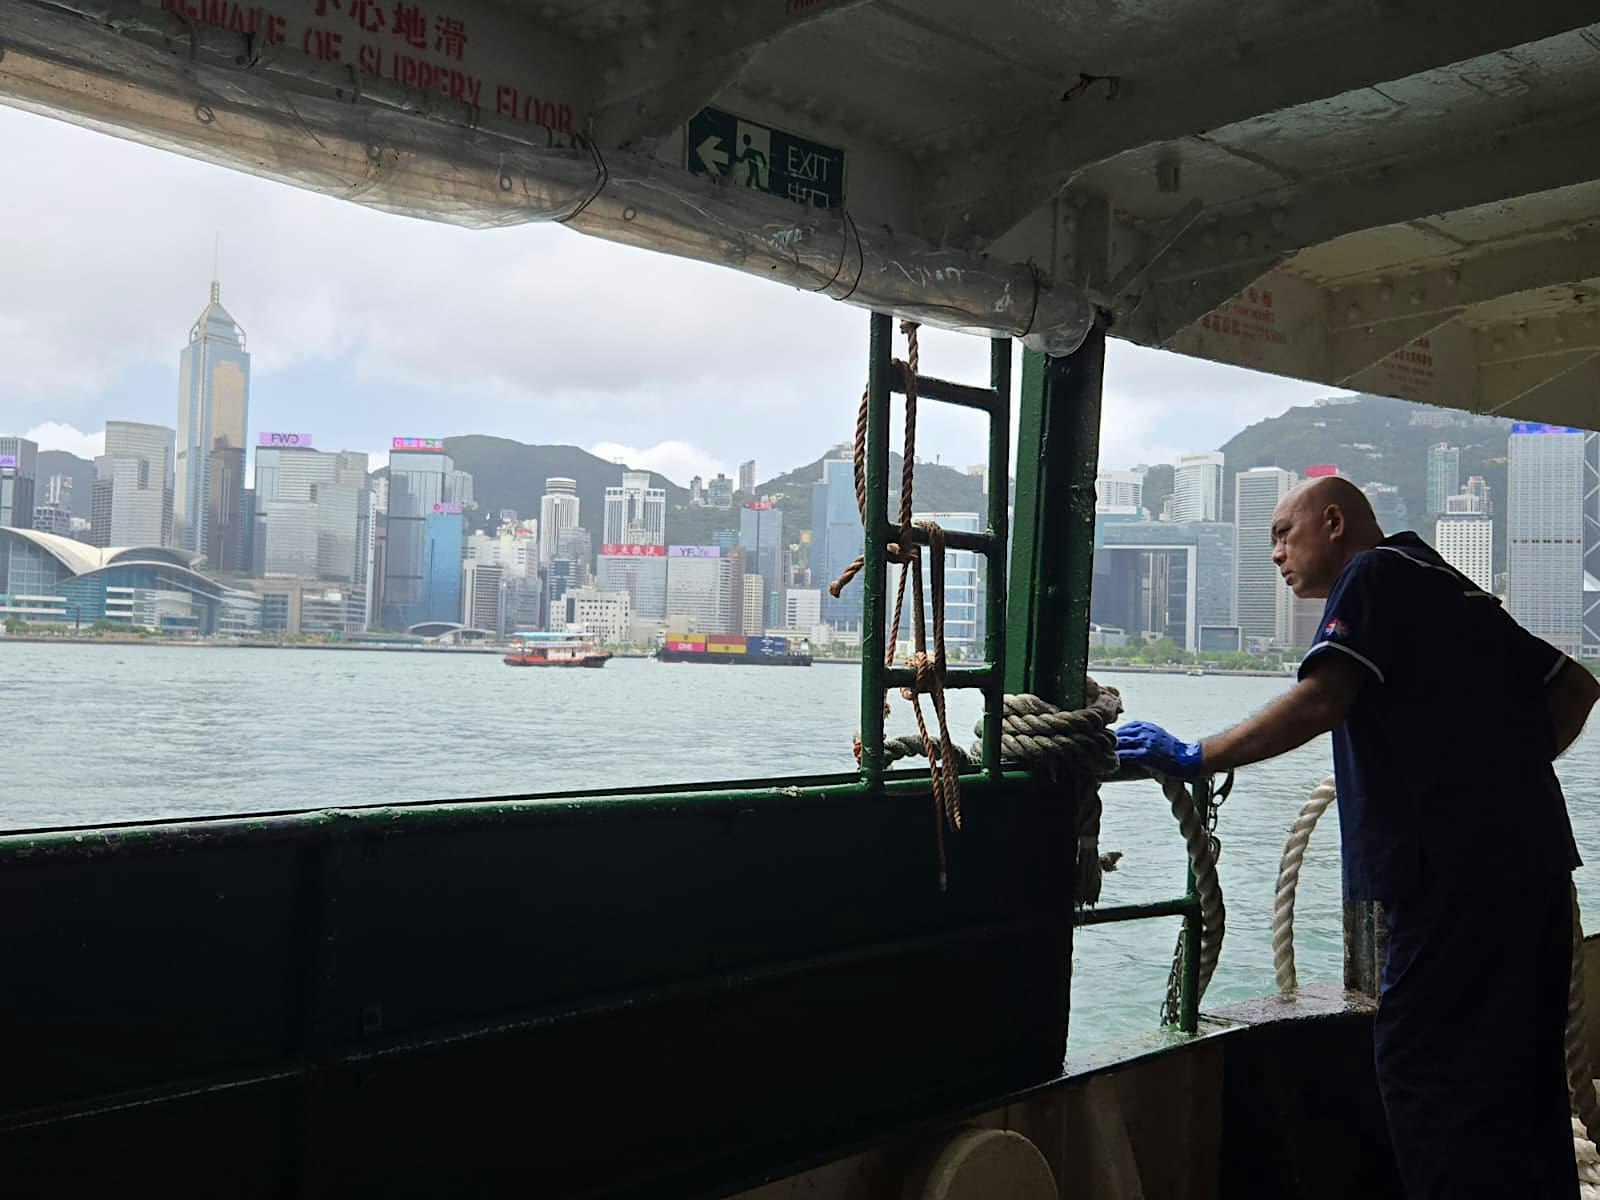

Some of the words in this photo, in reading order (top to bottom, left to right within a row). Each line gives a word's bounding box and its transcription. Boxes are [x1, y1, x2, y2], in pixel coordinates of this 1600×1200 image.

[303, 27, 343, 62] OF
[496, 83, 574, 132] FLOOR
[787, 144, 831, 182] EXIT
[788, 182, 830, 208] 出口
[271, 433, 299, 444] FWD
